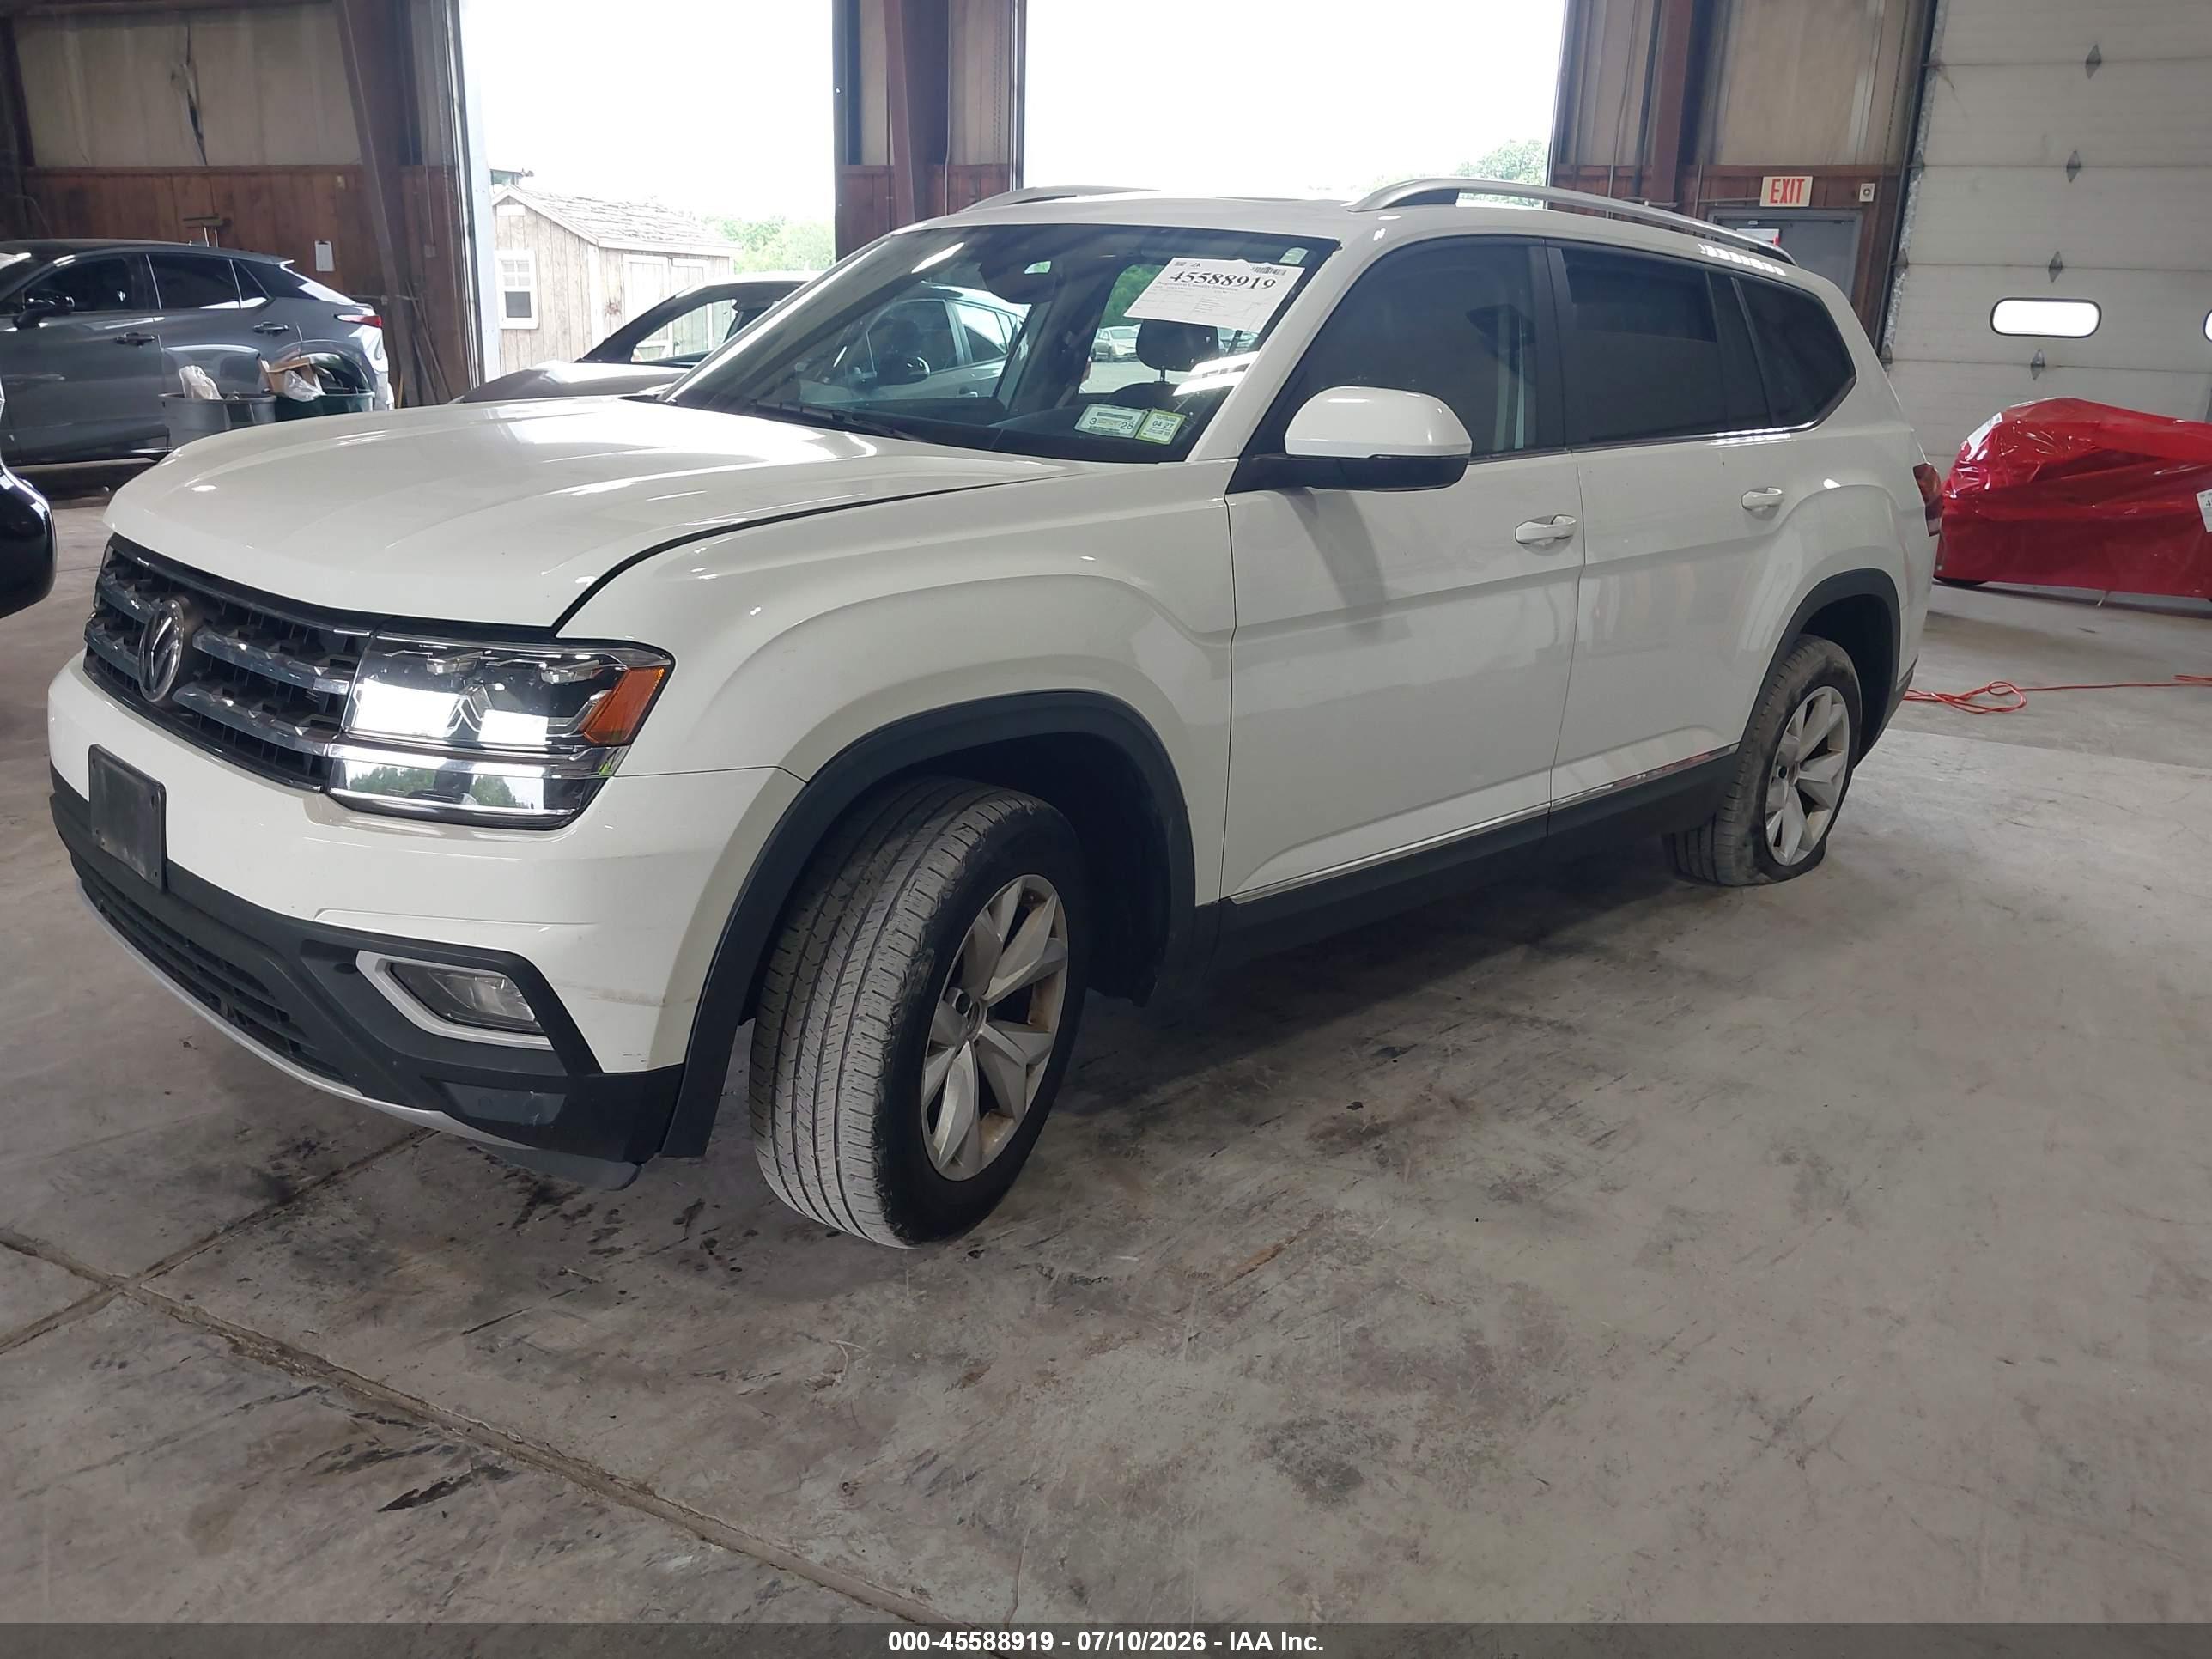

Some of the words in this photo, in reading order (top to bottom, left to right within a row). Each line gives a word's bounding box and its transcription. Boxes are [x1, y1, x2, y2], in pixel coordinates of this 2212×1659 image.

[1770, 178, 1805, 204] EXIT
[1170, 270, 1277, 289] 45588919
[1089, 417, 1097, 426] 3
[1120, 422, 1134, 430] 28
